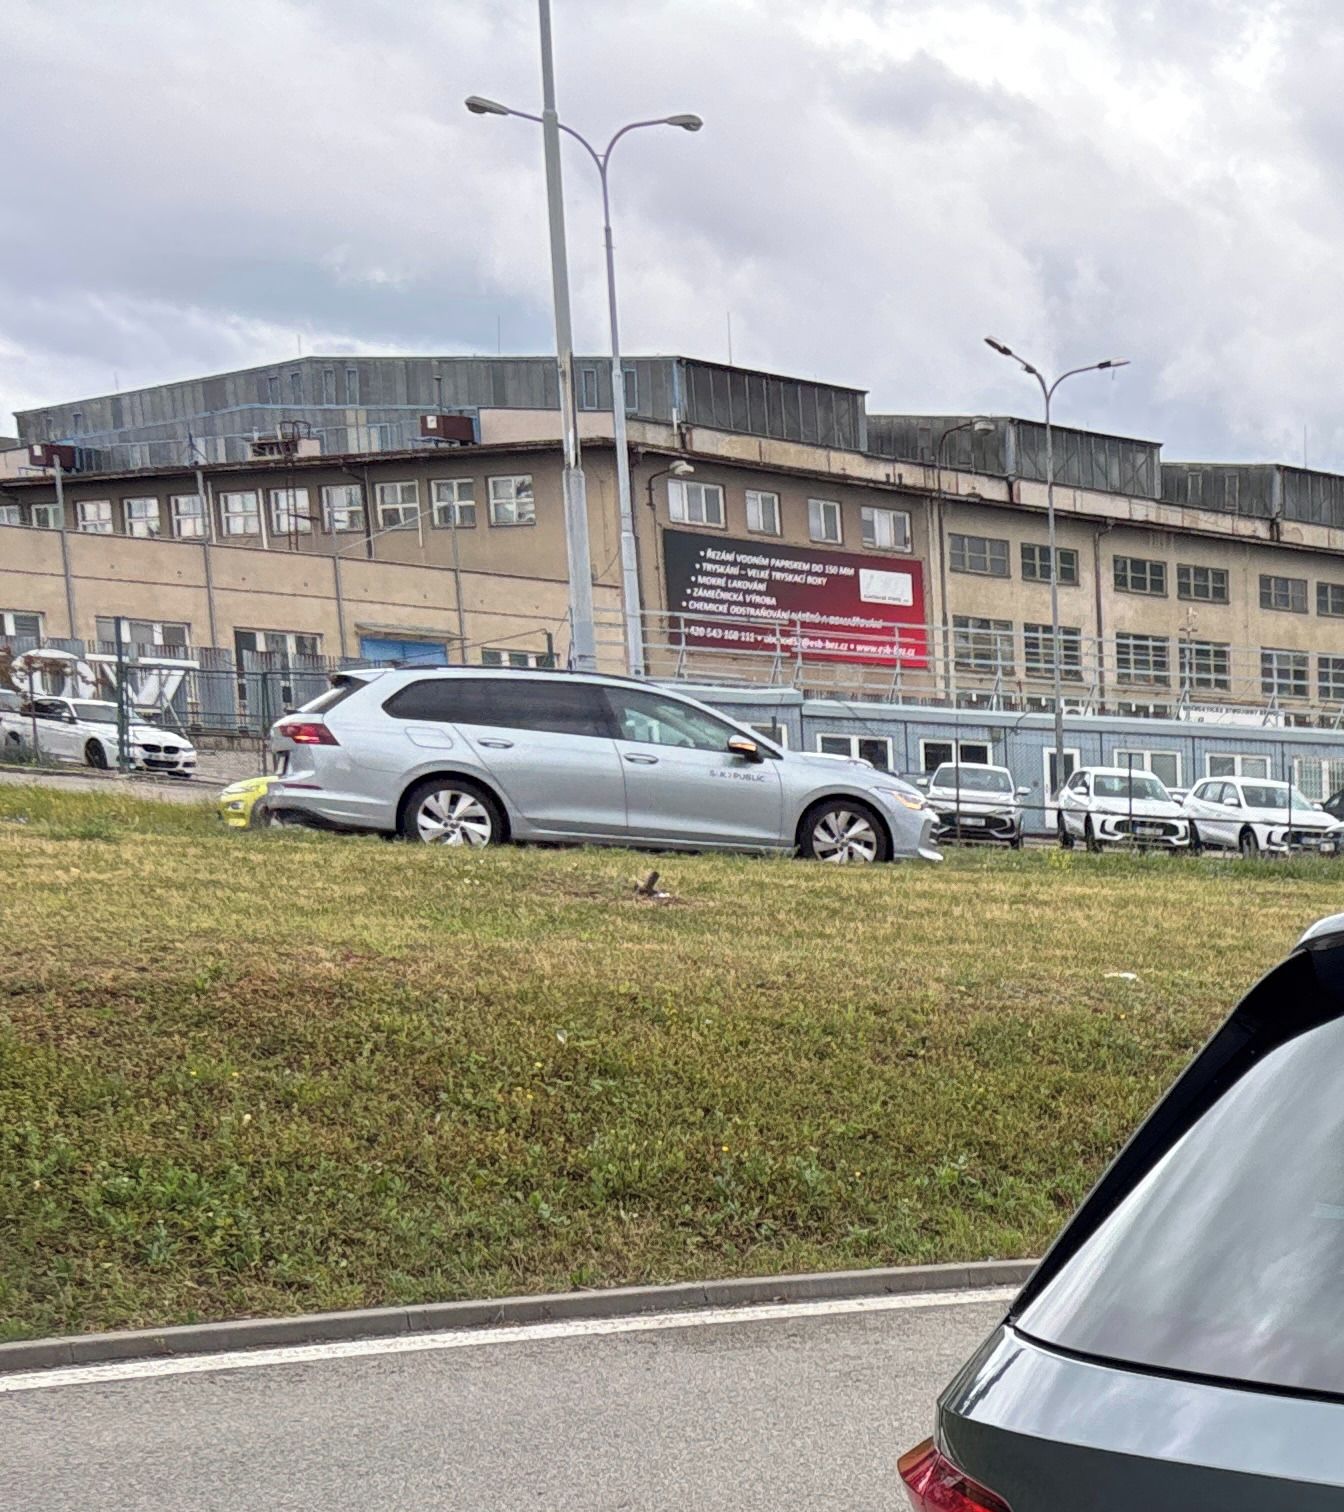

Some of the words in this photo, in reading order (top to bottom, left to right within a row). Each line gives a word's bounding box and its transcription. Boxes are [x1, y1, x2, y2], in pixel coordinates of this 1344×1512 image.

[811, 563, 823, 573] DO
[825, 564, 838, 575] 150
[697, 575, 726, 587] MOKRÉ
[728, 579, 767, 592] LAKOVÁNÍ
[745, 594, 777, 606] VÝROBA
[688, 600, 729, 613] CHEMICKÉ
